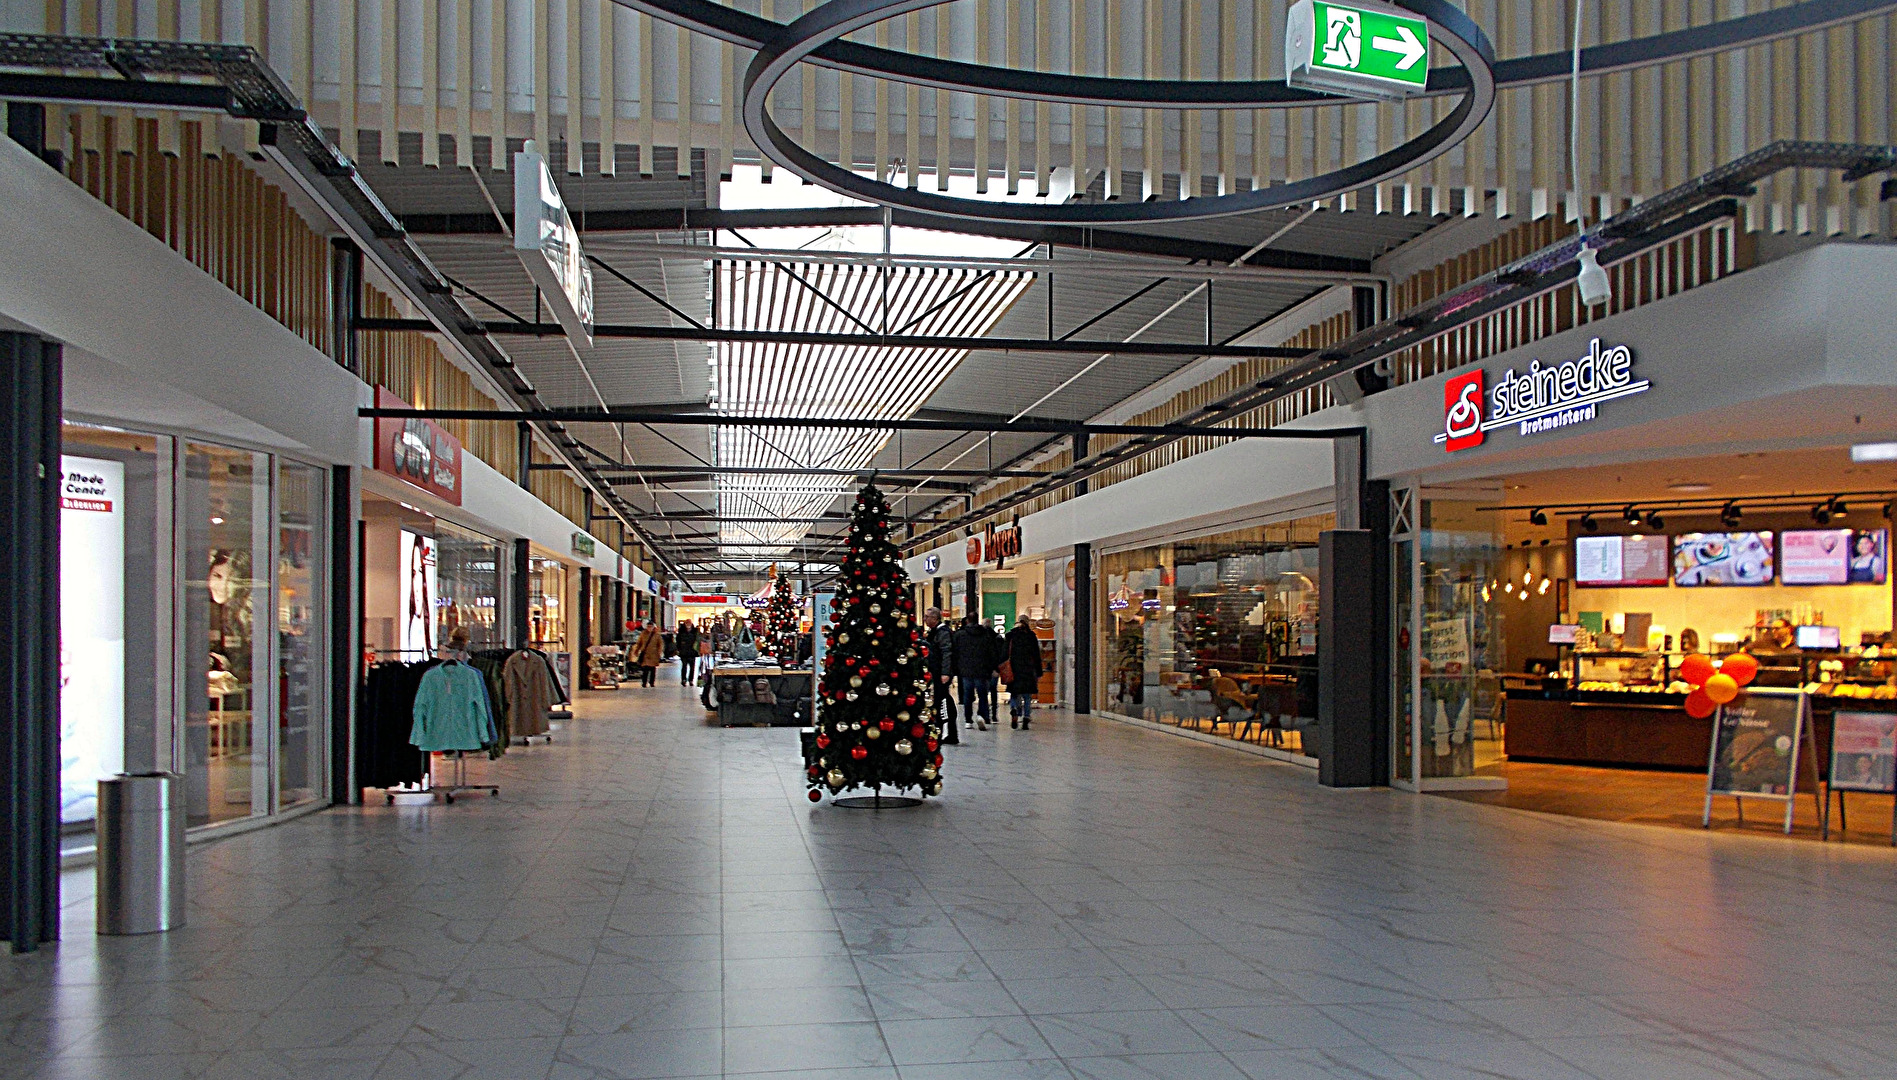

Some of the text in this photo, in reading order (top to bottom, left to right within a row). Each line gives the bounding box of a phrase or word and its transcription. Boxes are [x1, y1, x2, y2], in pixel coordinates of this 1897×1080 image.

[1493, 338, 1631, 419] steinecke
[1520, 404, 1596, 435] Brotmeisterei
[69, 473, 104, 484] Mode
[66, 484, 106, 495] Center
